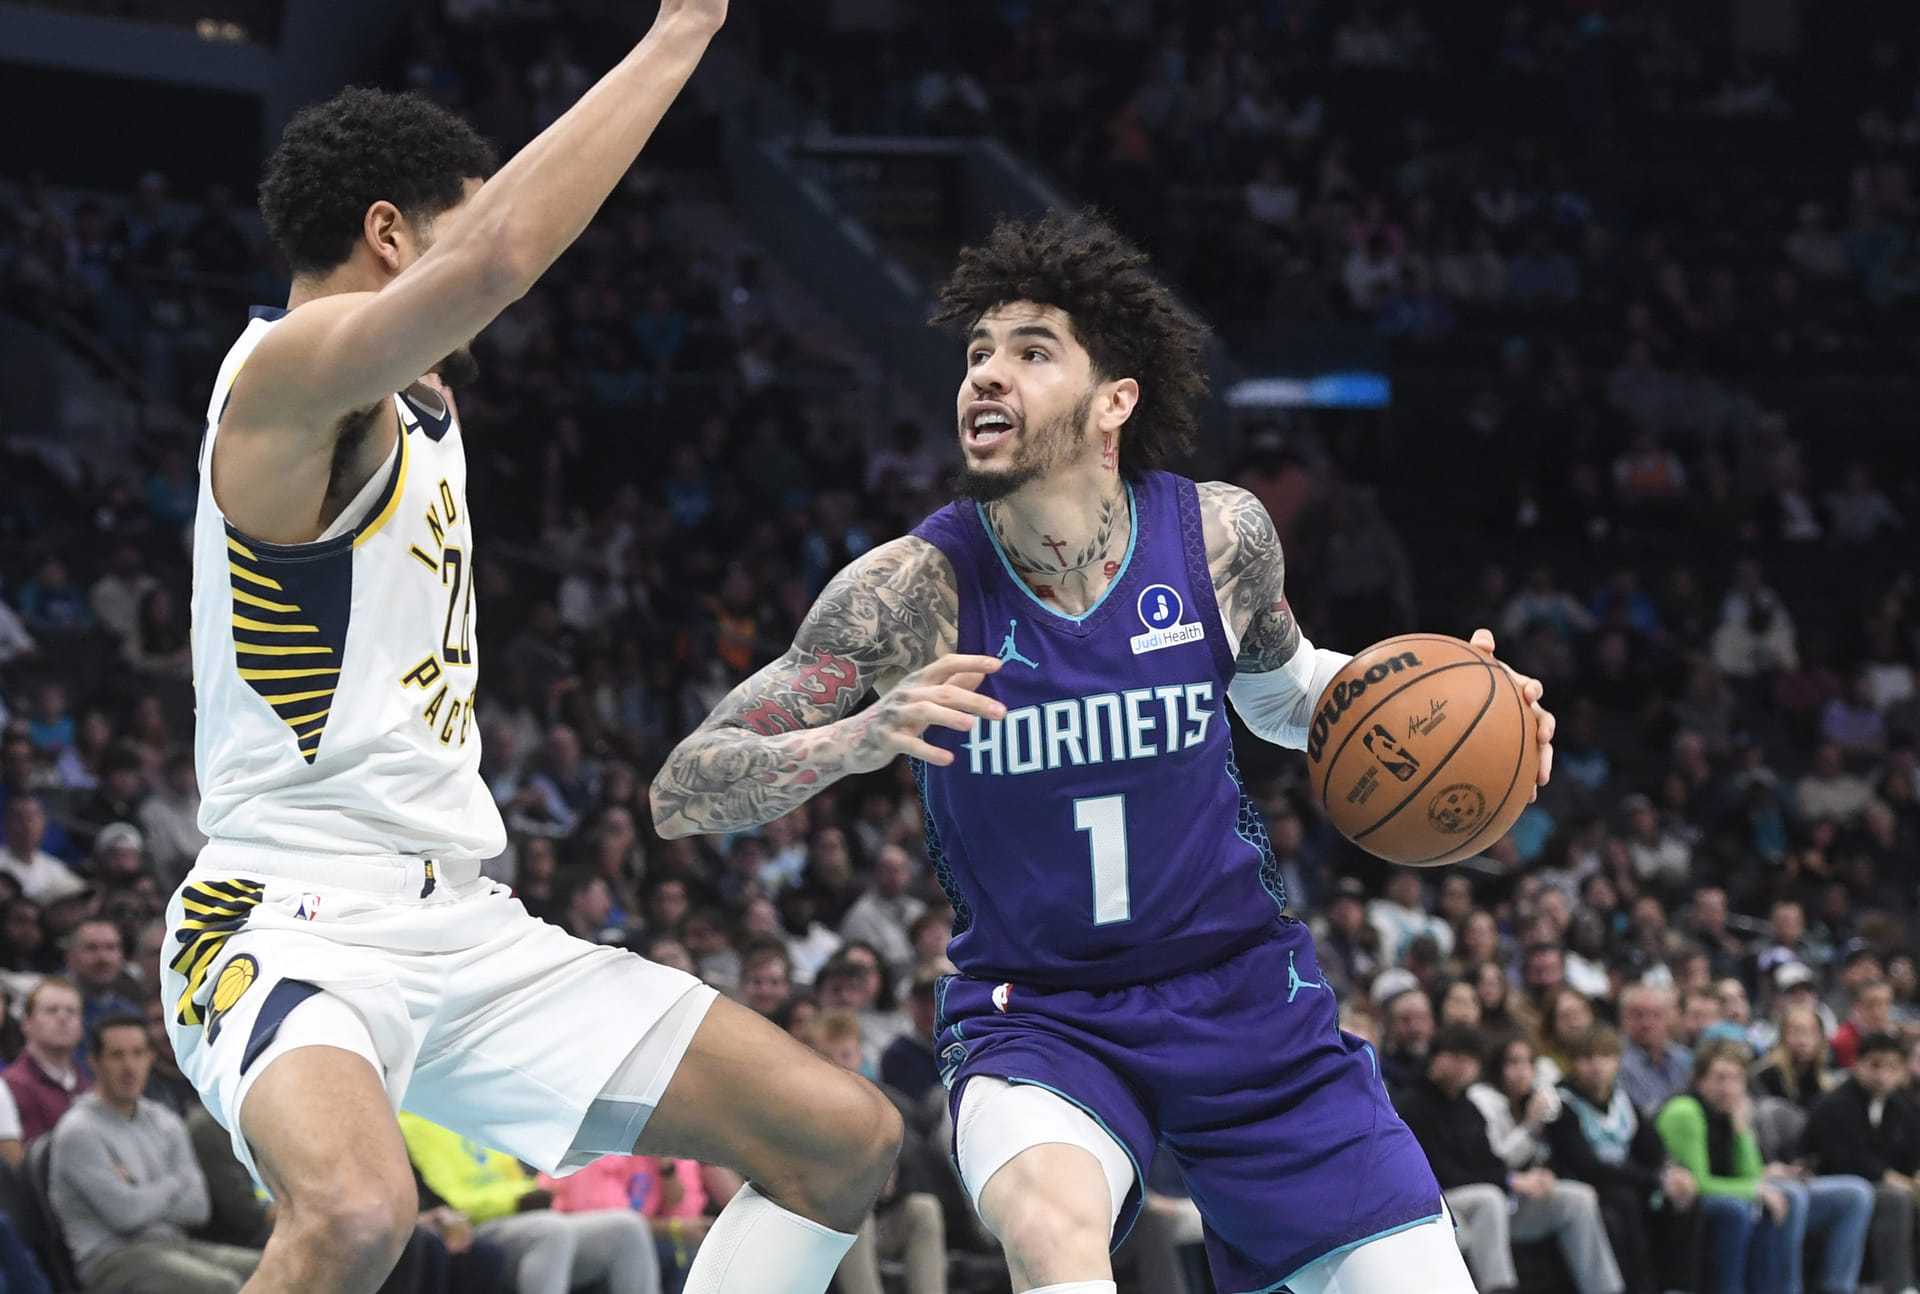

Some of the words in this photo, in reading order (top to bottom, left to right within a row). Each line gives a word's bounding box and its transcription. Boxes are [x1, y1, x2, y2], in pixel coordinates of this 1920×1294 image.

[408, 477, 465, 576] IND
[1134, 633, 1163, 651] Judi
[1163, 624, 1202, 644] Health
[399, 652, 478, 749] PACE
[961, 680, 1216, 776] HORNETS
[1308, 651, 1422, 764] Wilson
[1072, 793, 1132, 926] 1
